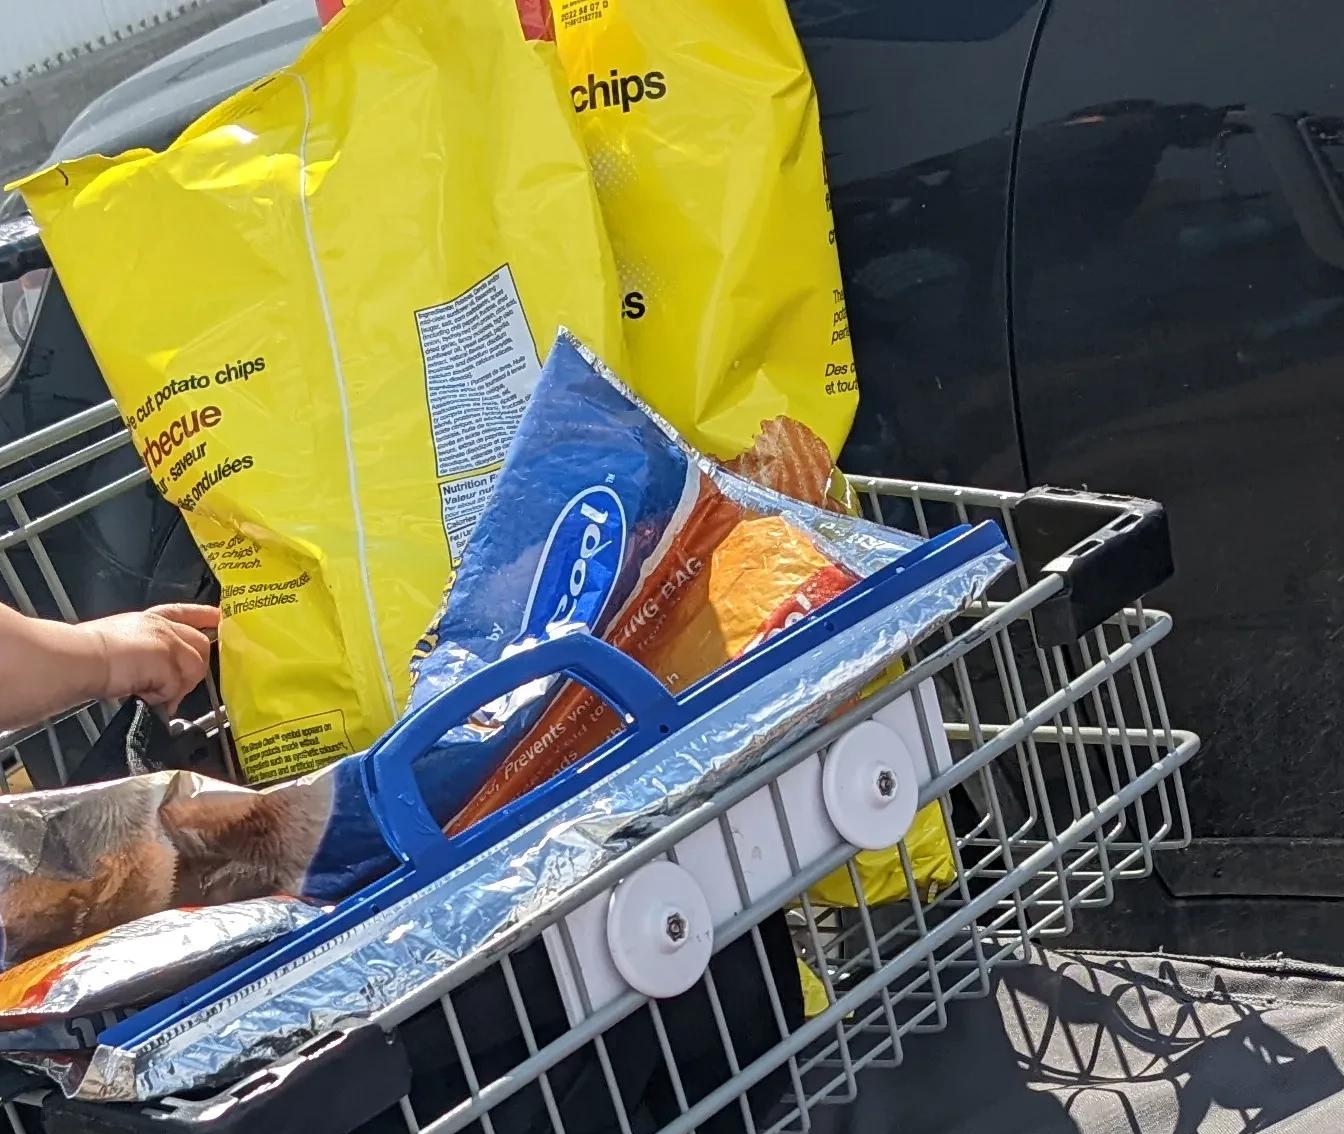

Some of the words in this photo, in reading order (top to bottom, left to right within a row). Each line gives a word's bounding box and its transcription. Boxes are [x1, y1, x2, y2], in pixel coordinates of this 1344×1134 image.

[570, 69, 667, 113] chips
[825, 363, 848, 377] Des
[136, 394, 155, 423] cut
[154, 375, 210, 411] potato
[215, 357, 266, 385] chips
[825, 381, 836, 395] et
[143, 405, 222, 474] rbecue
[169, 442, 207, 481] saveur
[191, 455, 254, 501] ondulées
[442, 478, 488, 495] Nutrition
[217, 558, 262, 570] crunch.
[222, 545, 254, 559] chips
[485, 622, 504, 642] by
[505, 722, 567, 780] Prevents
